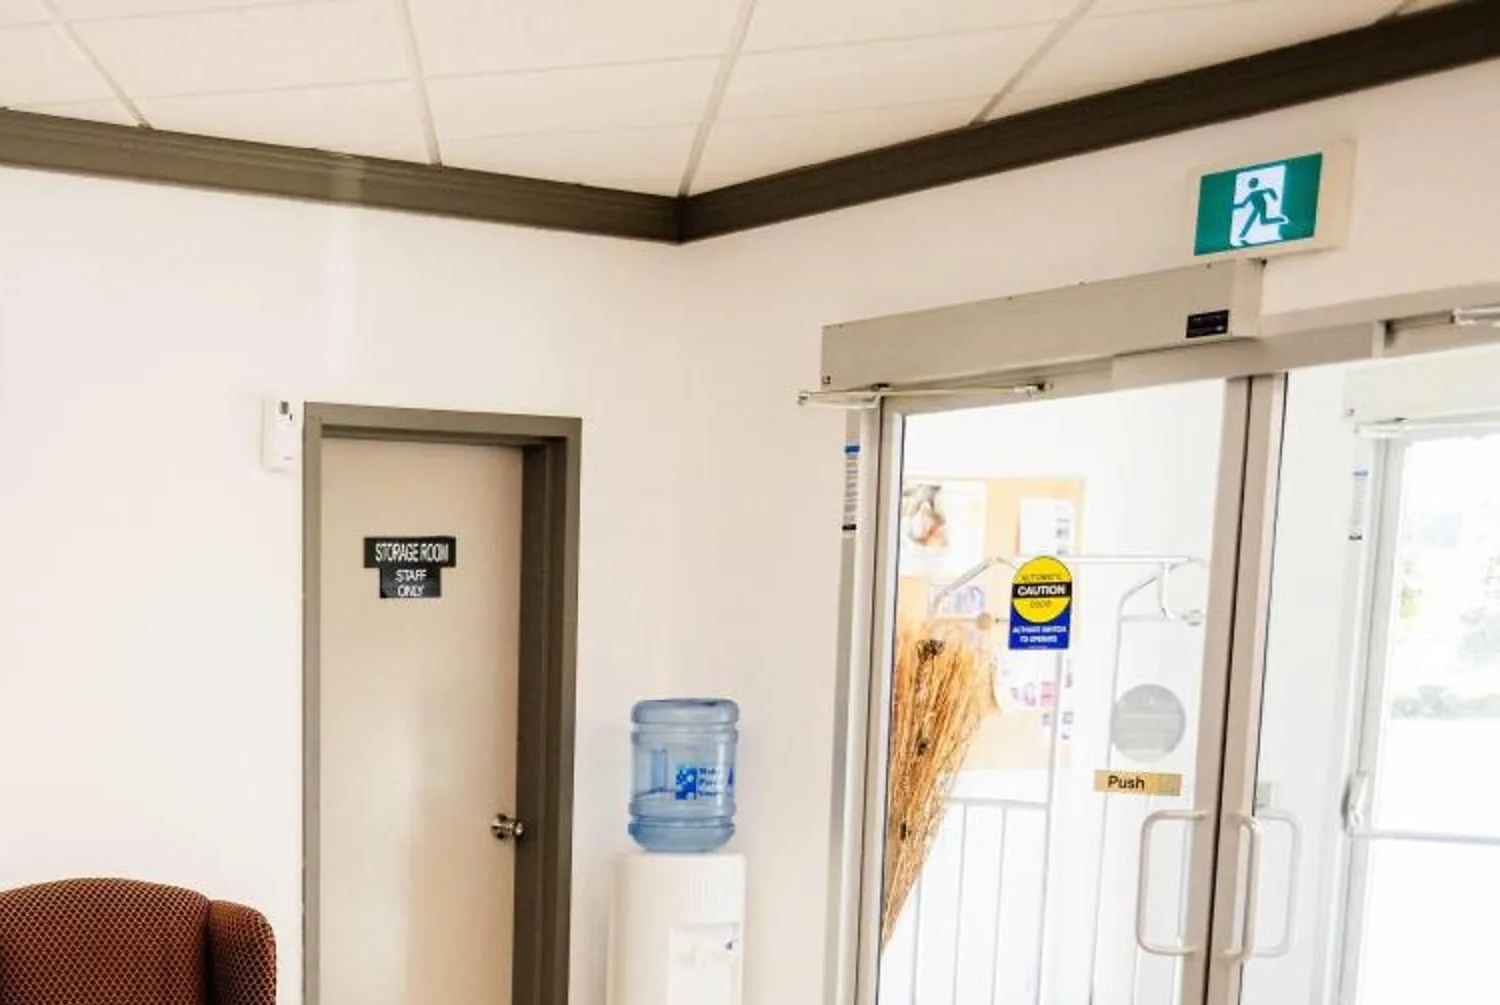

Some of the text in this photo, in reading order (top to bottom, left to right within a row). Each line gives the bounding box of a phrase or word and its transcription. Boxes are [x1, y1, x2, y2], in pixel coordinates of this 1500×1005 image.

[375, 543, 449, 562] STORAGE ROOM
[395, 569, 427, 582] STAFF
[397, 584, 425, 597] ONLY
[1017, 584, 1066, 596] CAUTION
[1107, 775, 1145, 791] Push
